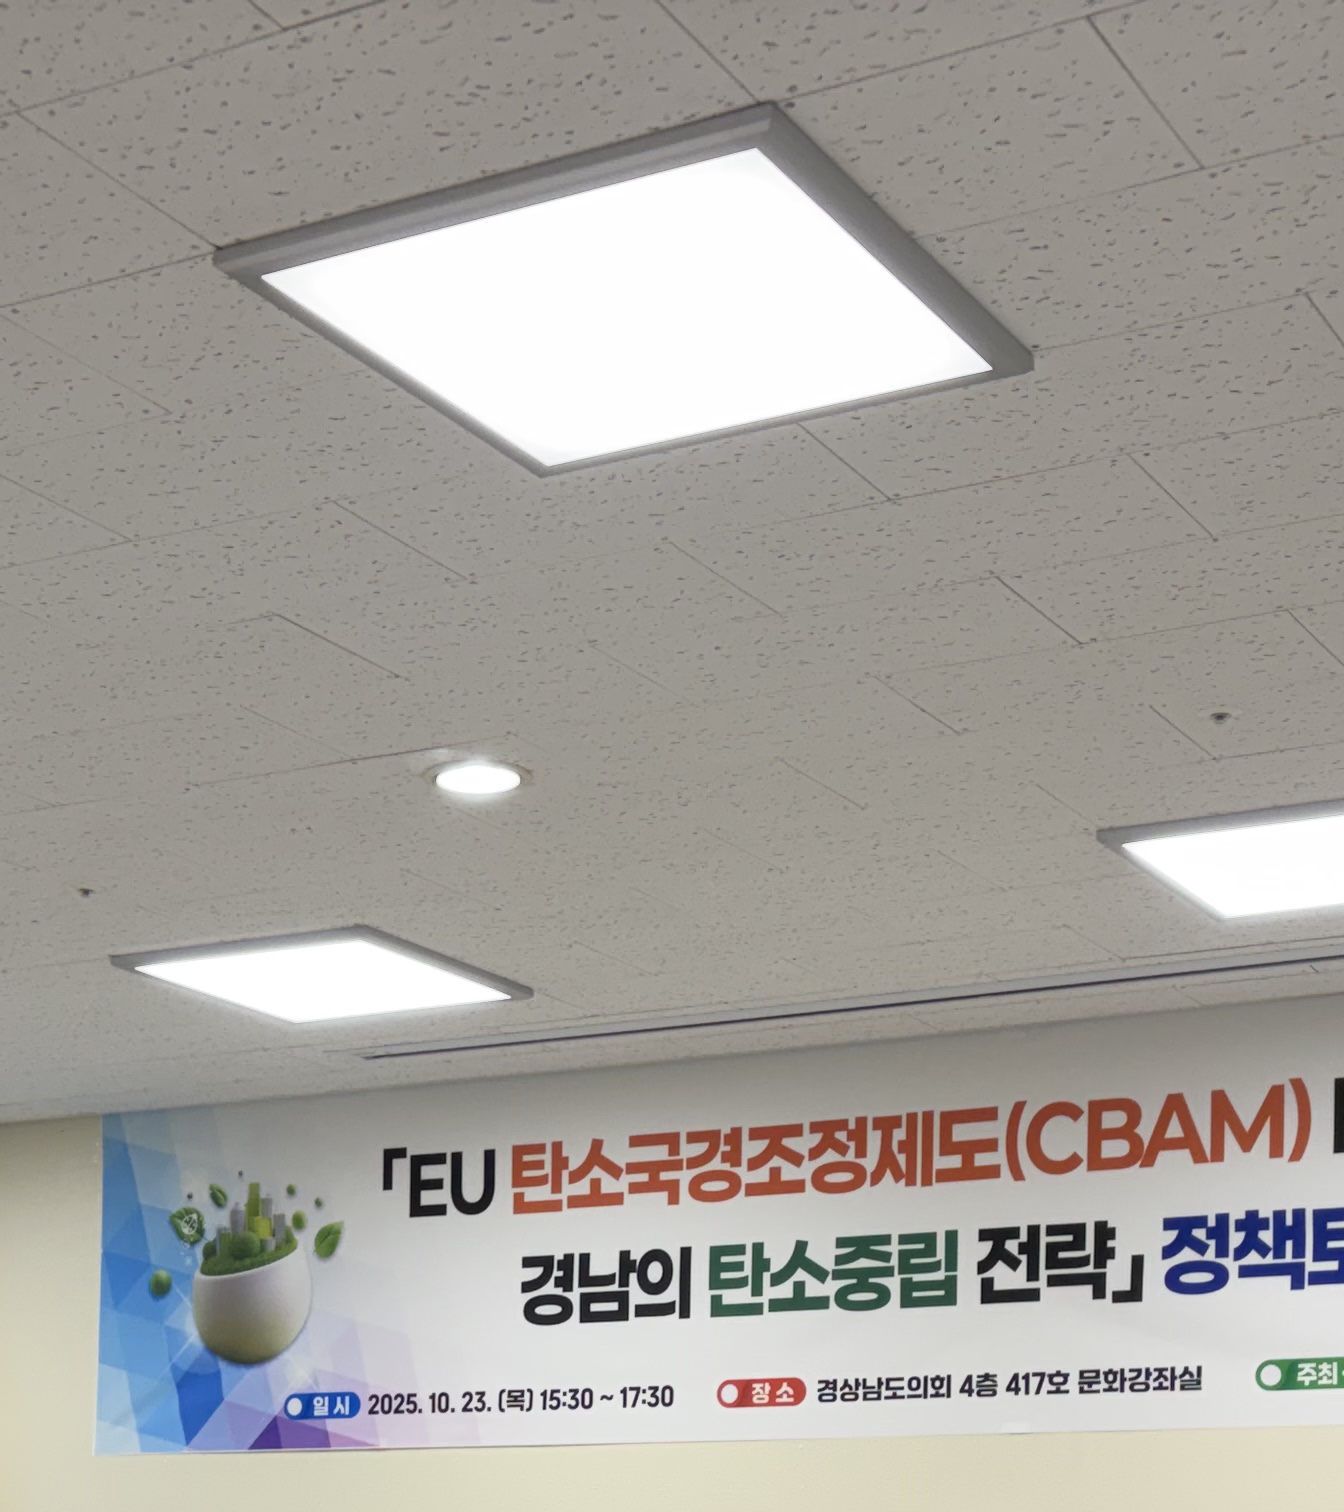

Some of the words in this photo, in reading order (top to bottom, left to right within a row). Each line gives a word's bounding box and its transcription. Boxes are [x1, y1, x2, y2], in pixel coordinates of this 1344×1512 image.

[382, 1148, 495, 1217] 「EU
[511, 1077, 1311, 1215] 탄소국경조정제도(CBAM)
[521, 1246, 692, 1326] 경남의
[708, 1229, 959, 1317] 탄소중립
[976, 1219, 1144, 1304] 전략」
[368, 1394, 423, 1415] 2025.
[429, 1392, 455, 1414] 10.
[462, 1391, 491, 1413] 23.
[498, 1389, 533, 1413] (목)
[540, 1387, 593, 1411] 15:30
[620, 1385, 674, 1408] 17:30
[817, 1373, 952, 1403] 경상남도의회
[959, 1373, 999, 1398] 4층
[1006, 1370, 1071, 1396] 417호
[1078, 1366, 1203, 1394] 문화강좌실
